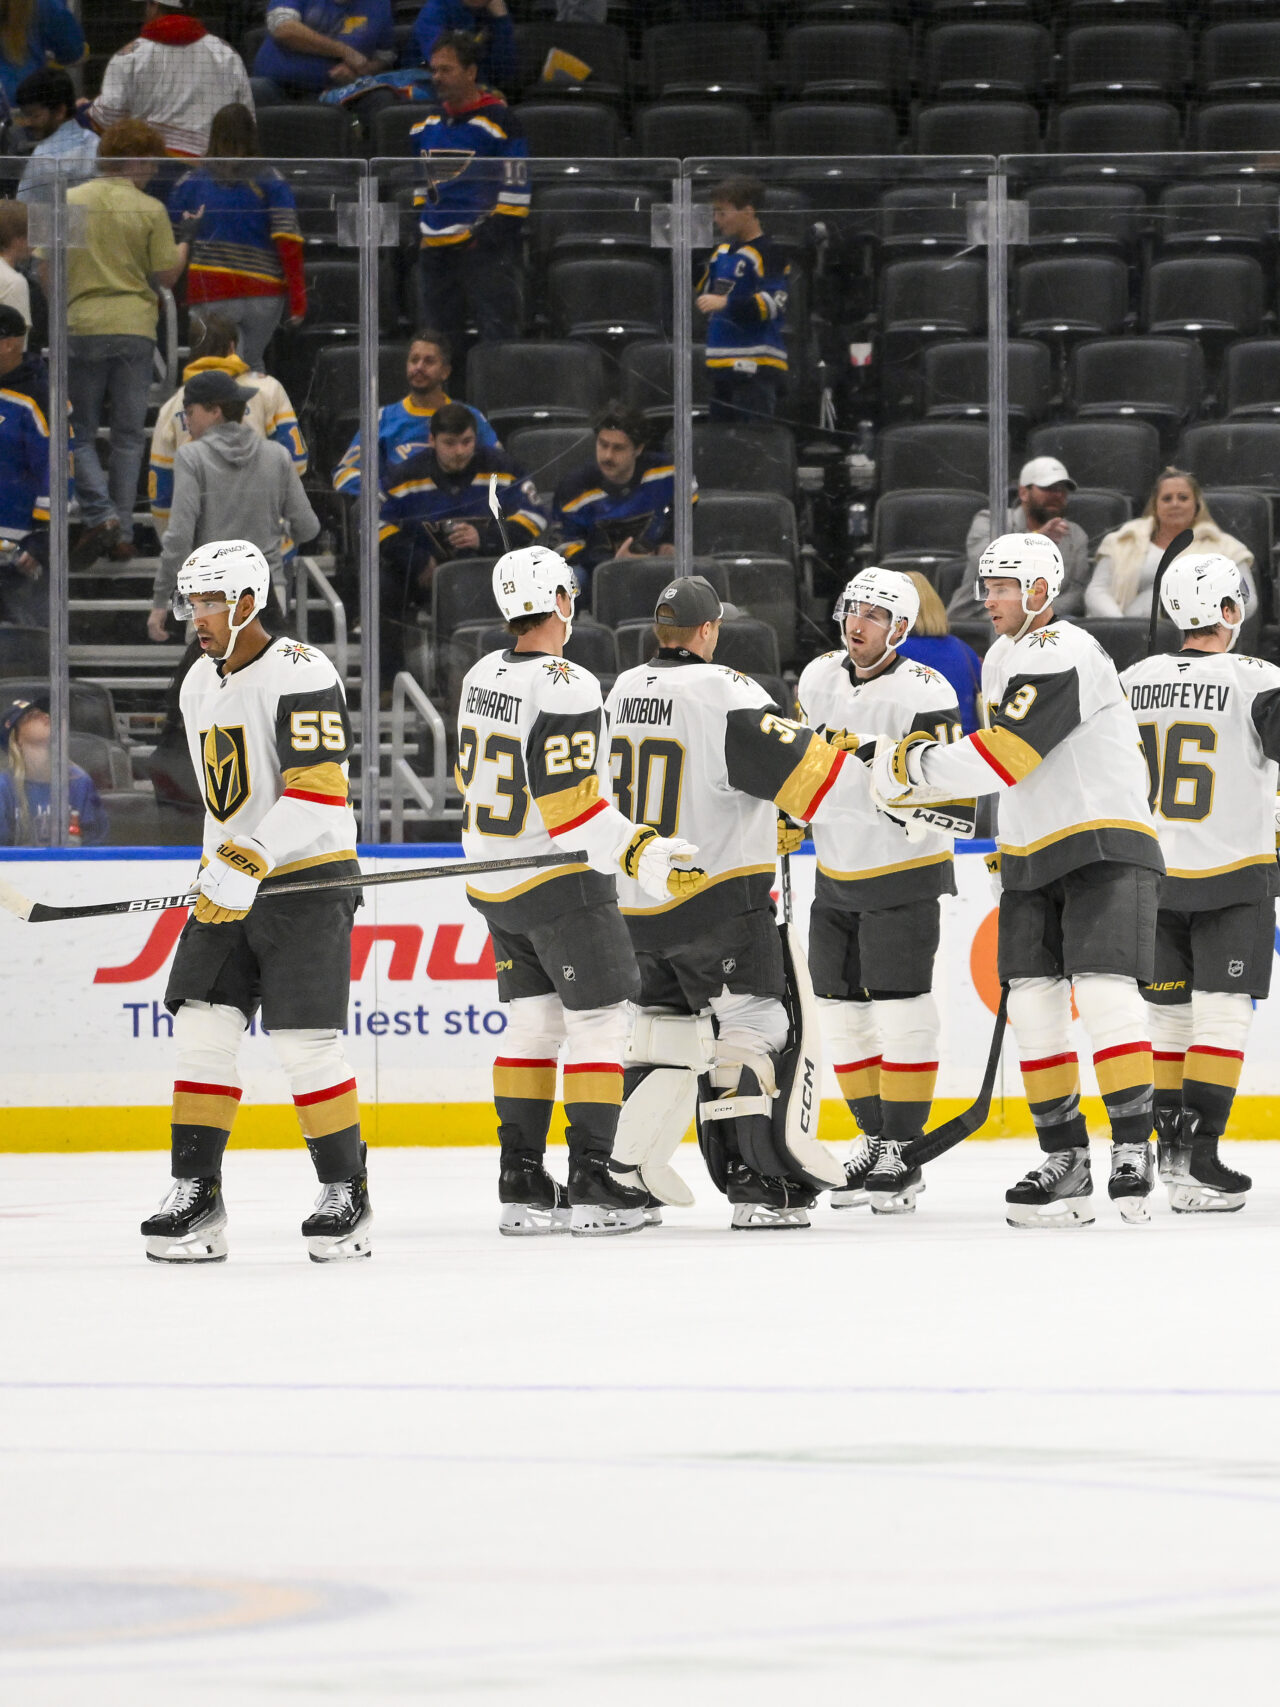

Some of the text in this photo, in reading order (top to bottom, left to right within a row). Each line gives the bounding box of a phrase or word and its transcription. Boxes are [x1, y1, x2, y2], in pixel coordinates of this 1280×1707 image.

[502, 581, 516, 595] 23
[1169, 599, 1181, 611] 16
[616, 698, 673, 726] LINDBOM
[1005, 684, 1038, 720] 3
[1131, 683, 1230, 711] DOROFEYEV
[291, 711, 346, 751] 55
[544, 731, 596, 775] 23
[459, 725, 531, 838] 23
[608, 735, 687, 839] 30
[1137, 720, 1218, 823] 16
[912, 808, 974, 834] CCM
[127, 893, 199, 912] BAUE
[123, 1000, 174, 1037] Th
[444, 1004, 508, 1036] sto
[800, 1056, 815, 1134] CCM
